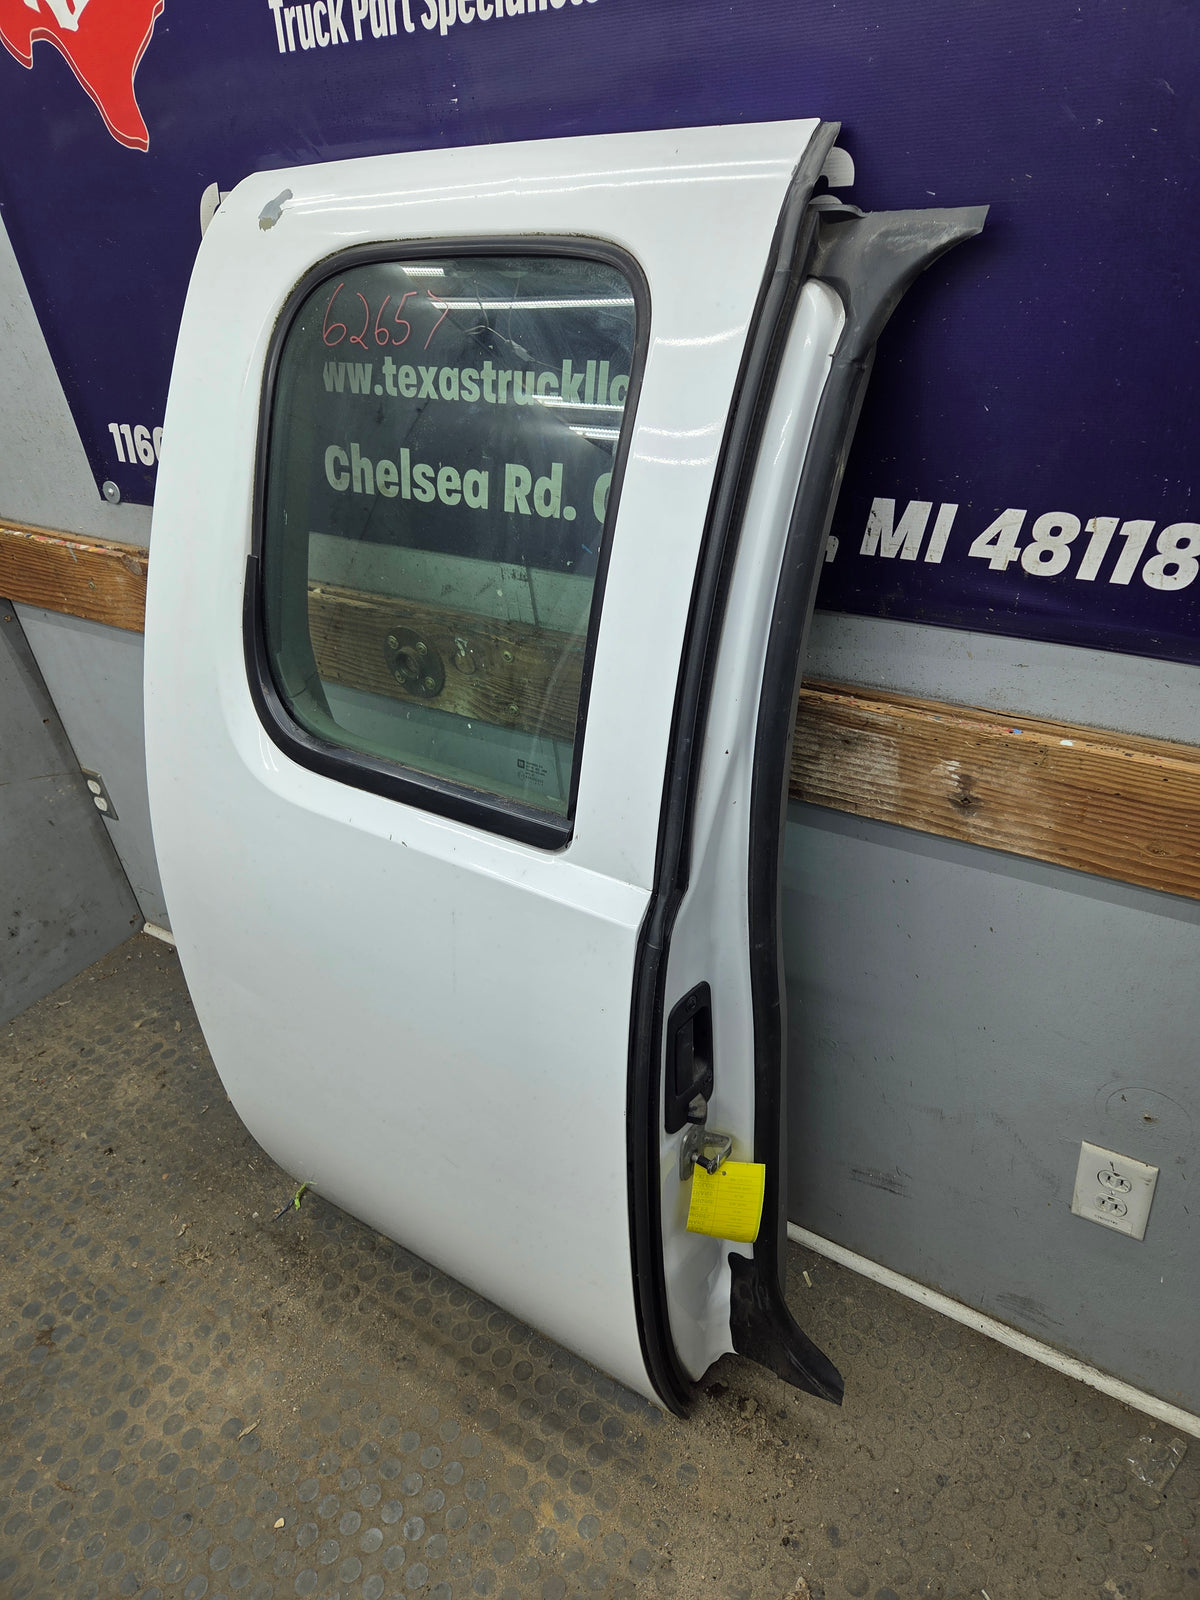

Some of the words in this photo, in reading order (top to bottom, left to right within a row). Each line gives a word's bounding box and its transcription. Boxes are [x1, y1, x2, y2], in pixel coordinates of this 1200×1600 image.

[269, 0, 349, 53] Truck
[322, 283, 449, 350] 62657
[325, 442, 489, 510] Chelsea
[504, 463, 577, 521] Rd.
[859, 497, 959, 564] MI
[968, 508, 1200, 591] 48118
